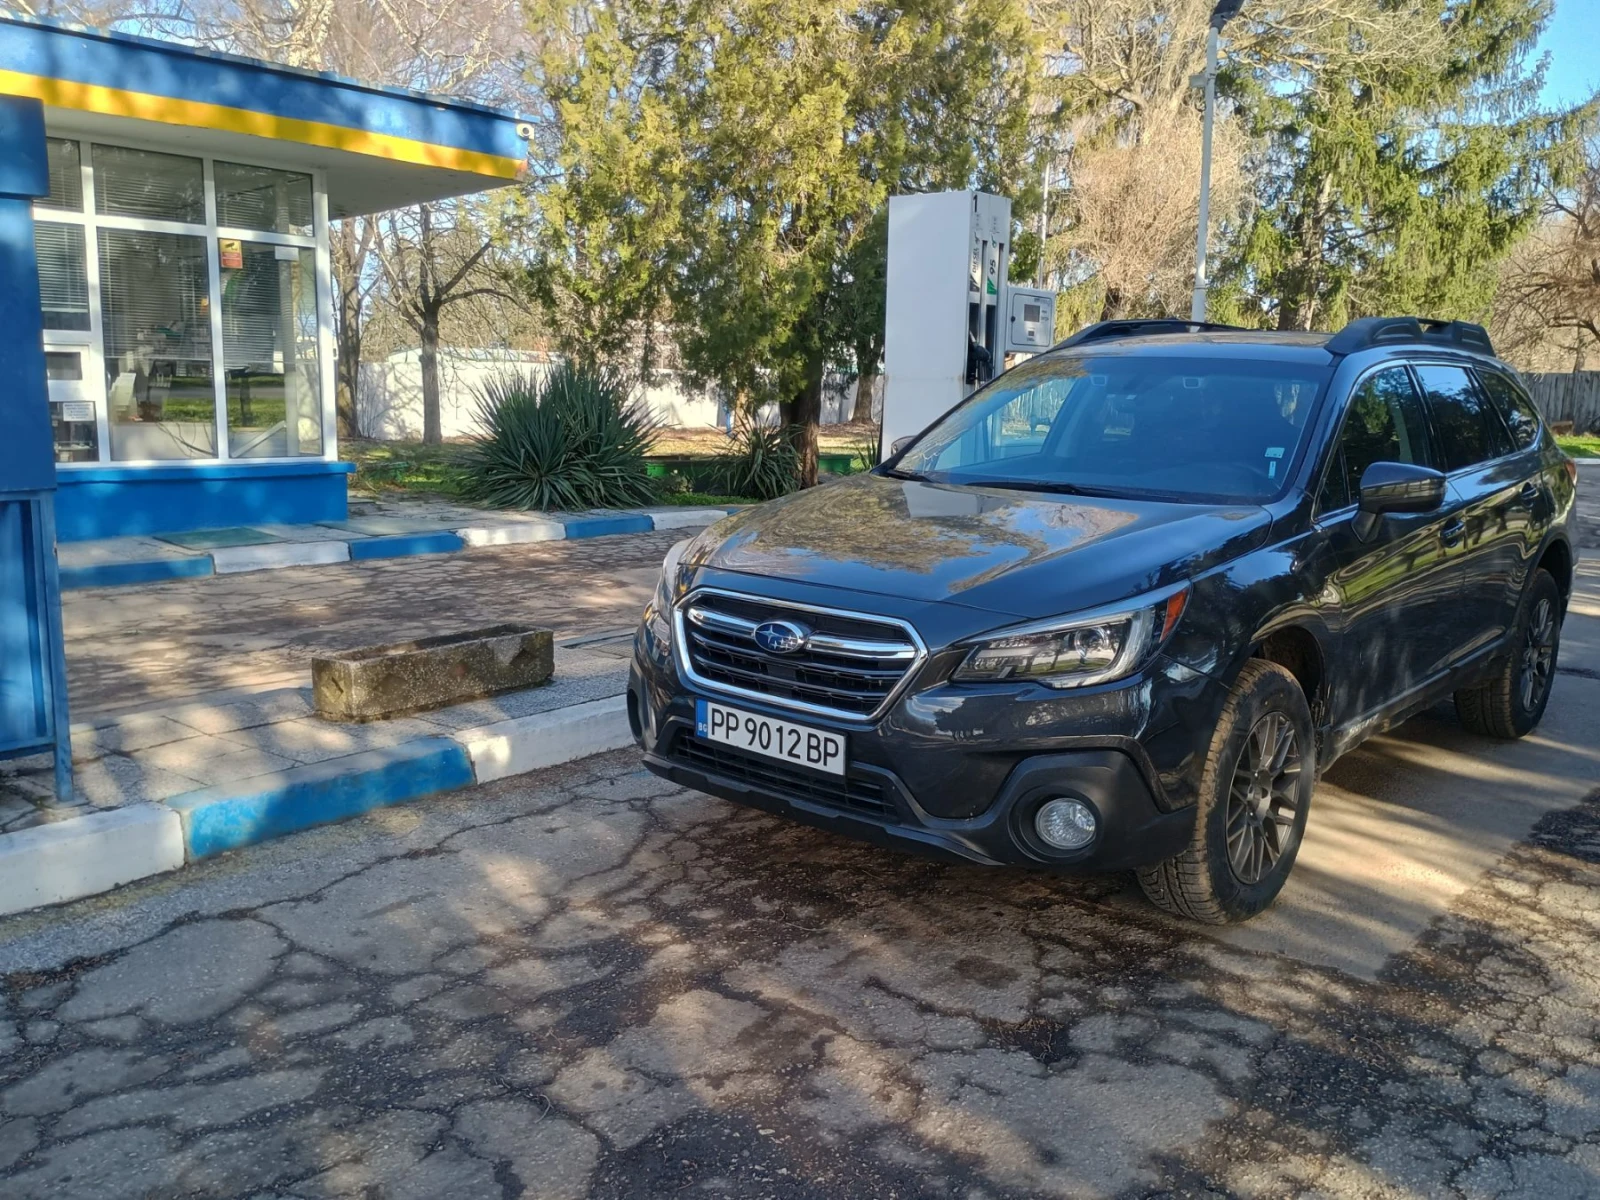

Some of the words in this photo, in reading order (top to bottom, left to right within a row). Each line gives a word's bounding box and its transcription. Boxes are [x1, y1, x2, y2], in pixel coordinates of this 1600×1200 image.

[989, 259, 996, 275] 95
[711, 707, 739, 740] PP
[744, 717, 801, 759] 9012
[806, 732, 839, 766] BP
